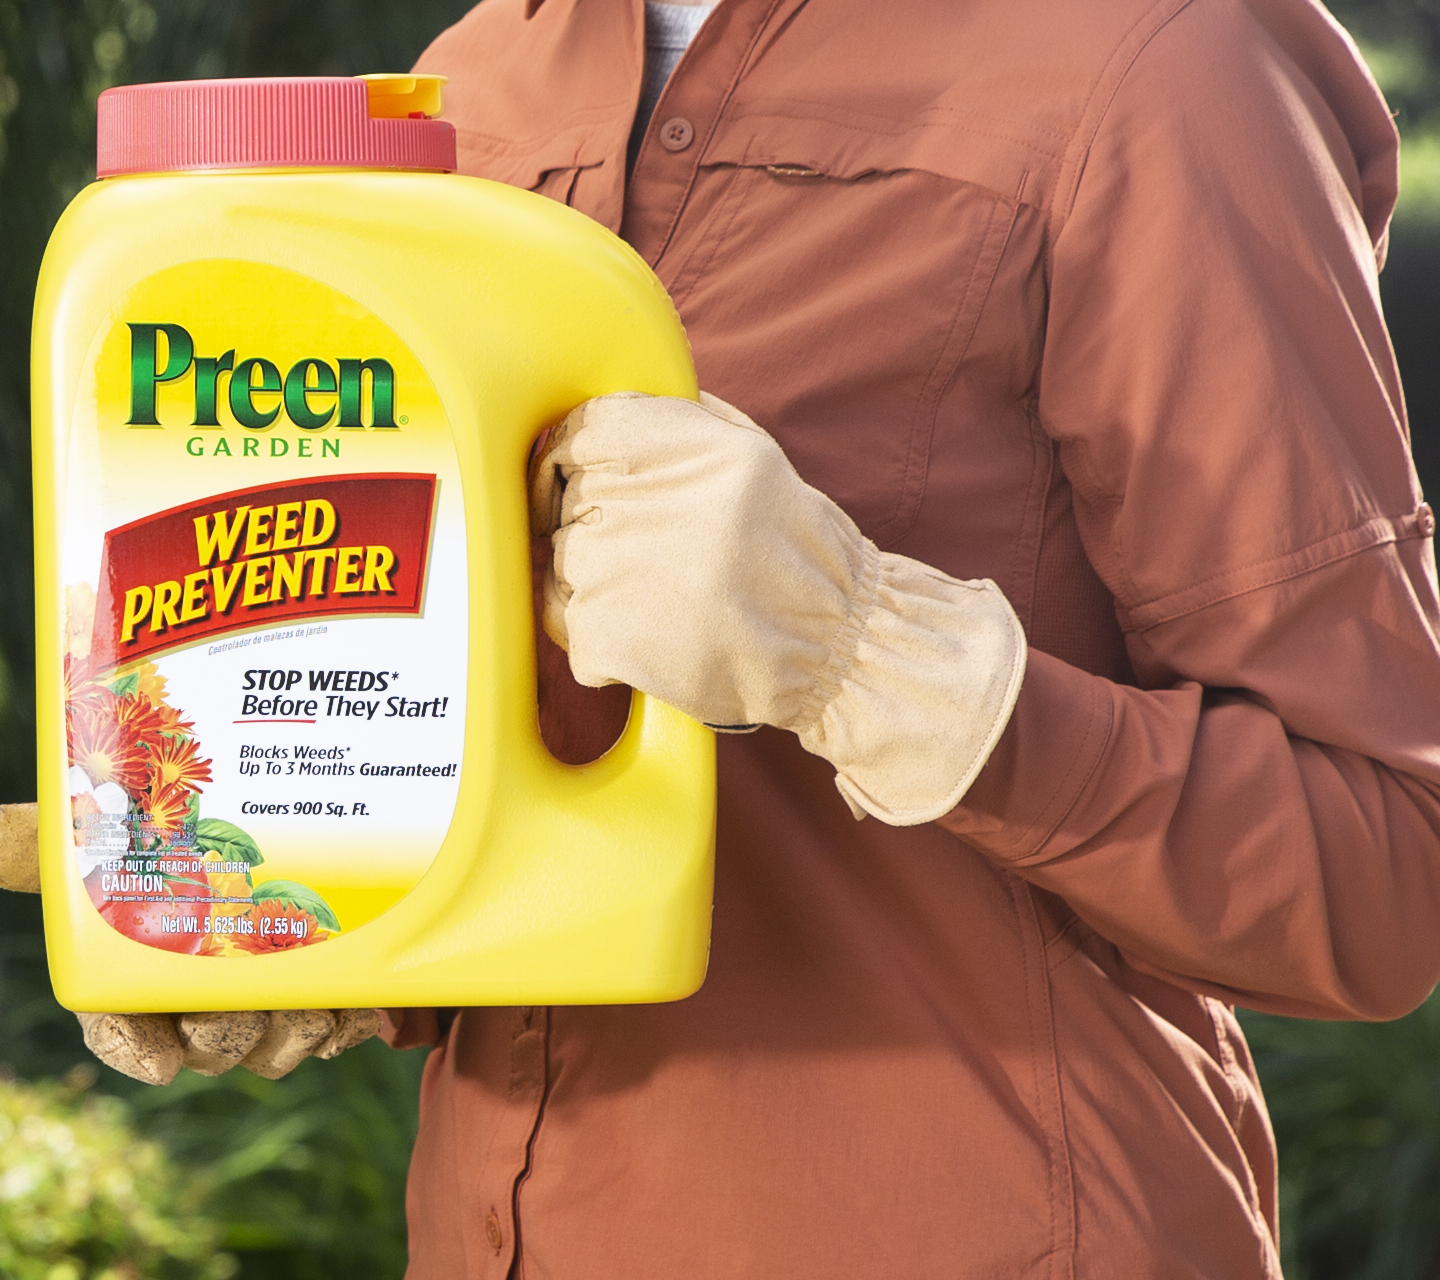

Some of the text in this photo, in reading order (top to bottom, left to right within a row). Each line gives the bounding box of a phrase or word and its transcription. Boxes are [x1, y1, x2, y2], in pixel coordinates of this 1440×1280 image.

[124, 322, 399, 429] Preen
[186, 436, 341, 458] GARDEN
[193, 498, 337, 567] WEED
[119, 545, 395, 643] PREVENTER
[208, 638, 251, 655] Controlador
[295, 628, 304, 637] de
[242, 669, 302, 690] STOP
[241, 694, 449, 720] Before They Start!
[239, 745, 288, 759] Blocks
[239, 761, 458, 777] Up To 3 Months Guaranteed!
[241, 801, 370, 817] Covers 900 Sq. Ft.
[101, 859, 250, 873] KEEP OUT OF REACH OF CHILDREN
[101, 874, 163, 892] CAUTION
[161, 916, 308, 938] Net Wt. 5.625 lbs. (2.55 kg)
